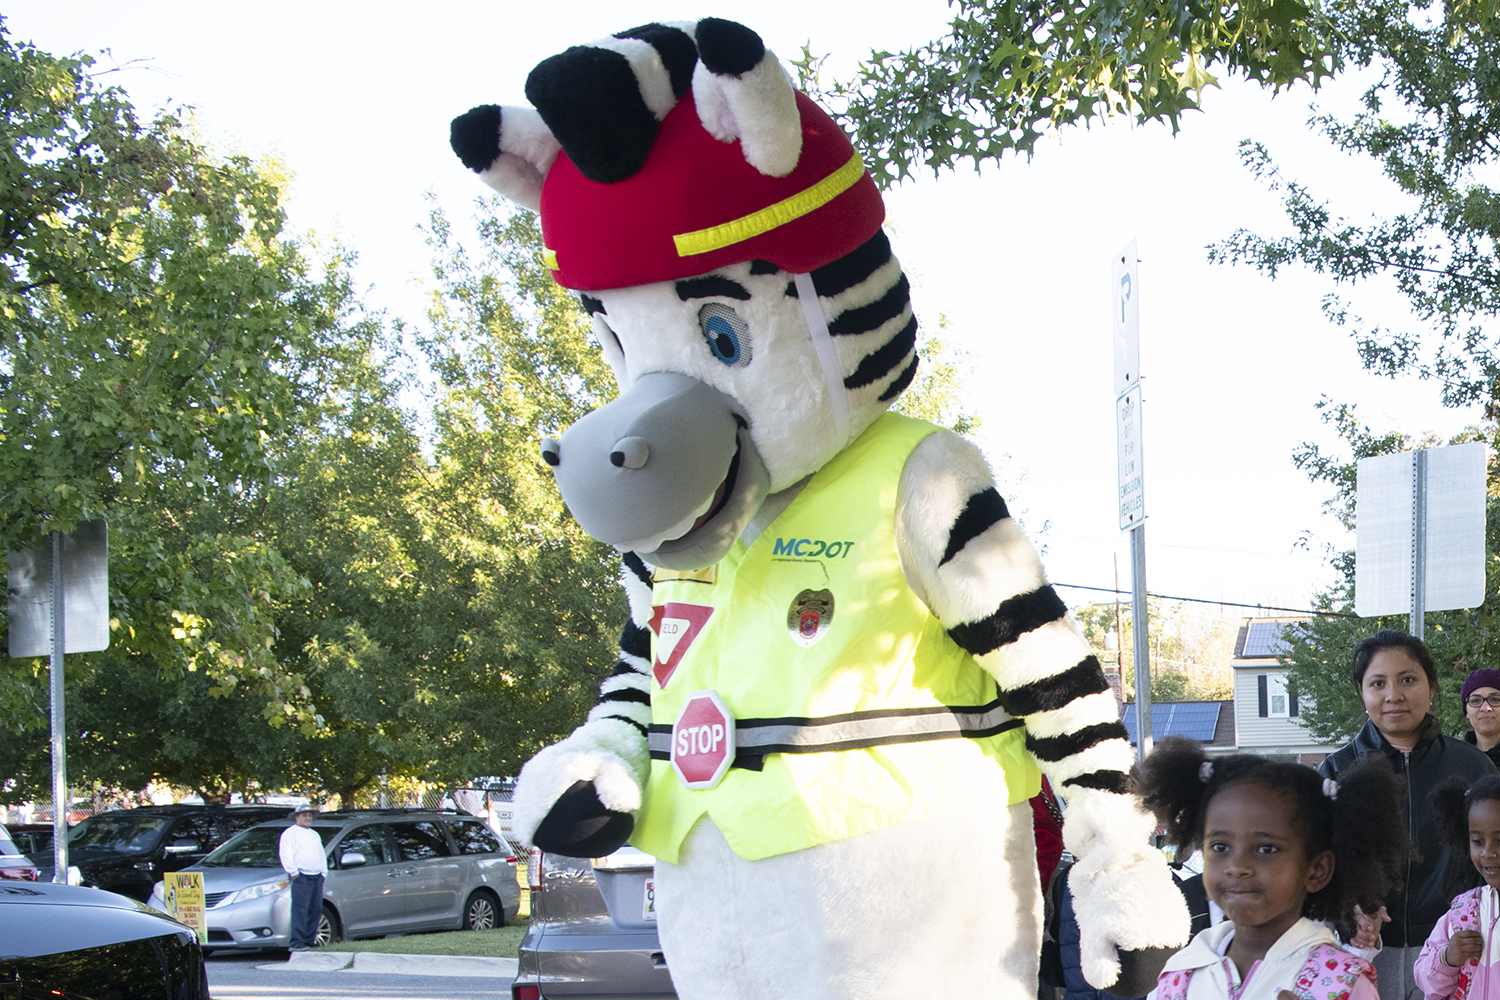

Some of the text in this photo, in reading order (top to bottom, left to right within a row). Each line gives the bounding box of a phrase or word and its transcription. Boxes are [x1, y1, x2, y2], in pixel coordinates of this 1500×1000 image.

[1121, 402, 1134, 420] DROP
[1124, 441, 1134, 457] FOR
[1120, 475, 1141, 498] EMISSION
[1121, 494, 1142, 516] VEHICLES
[772, 537, 855, 559] MCDOT
[677, 723, 724, 757] STOP
